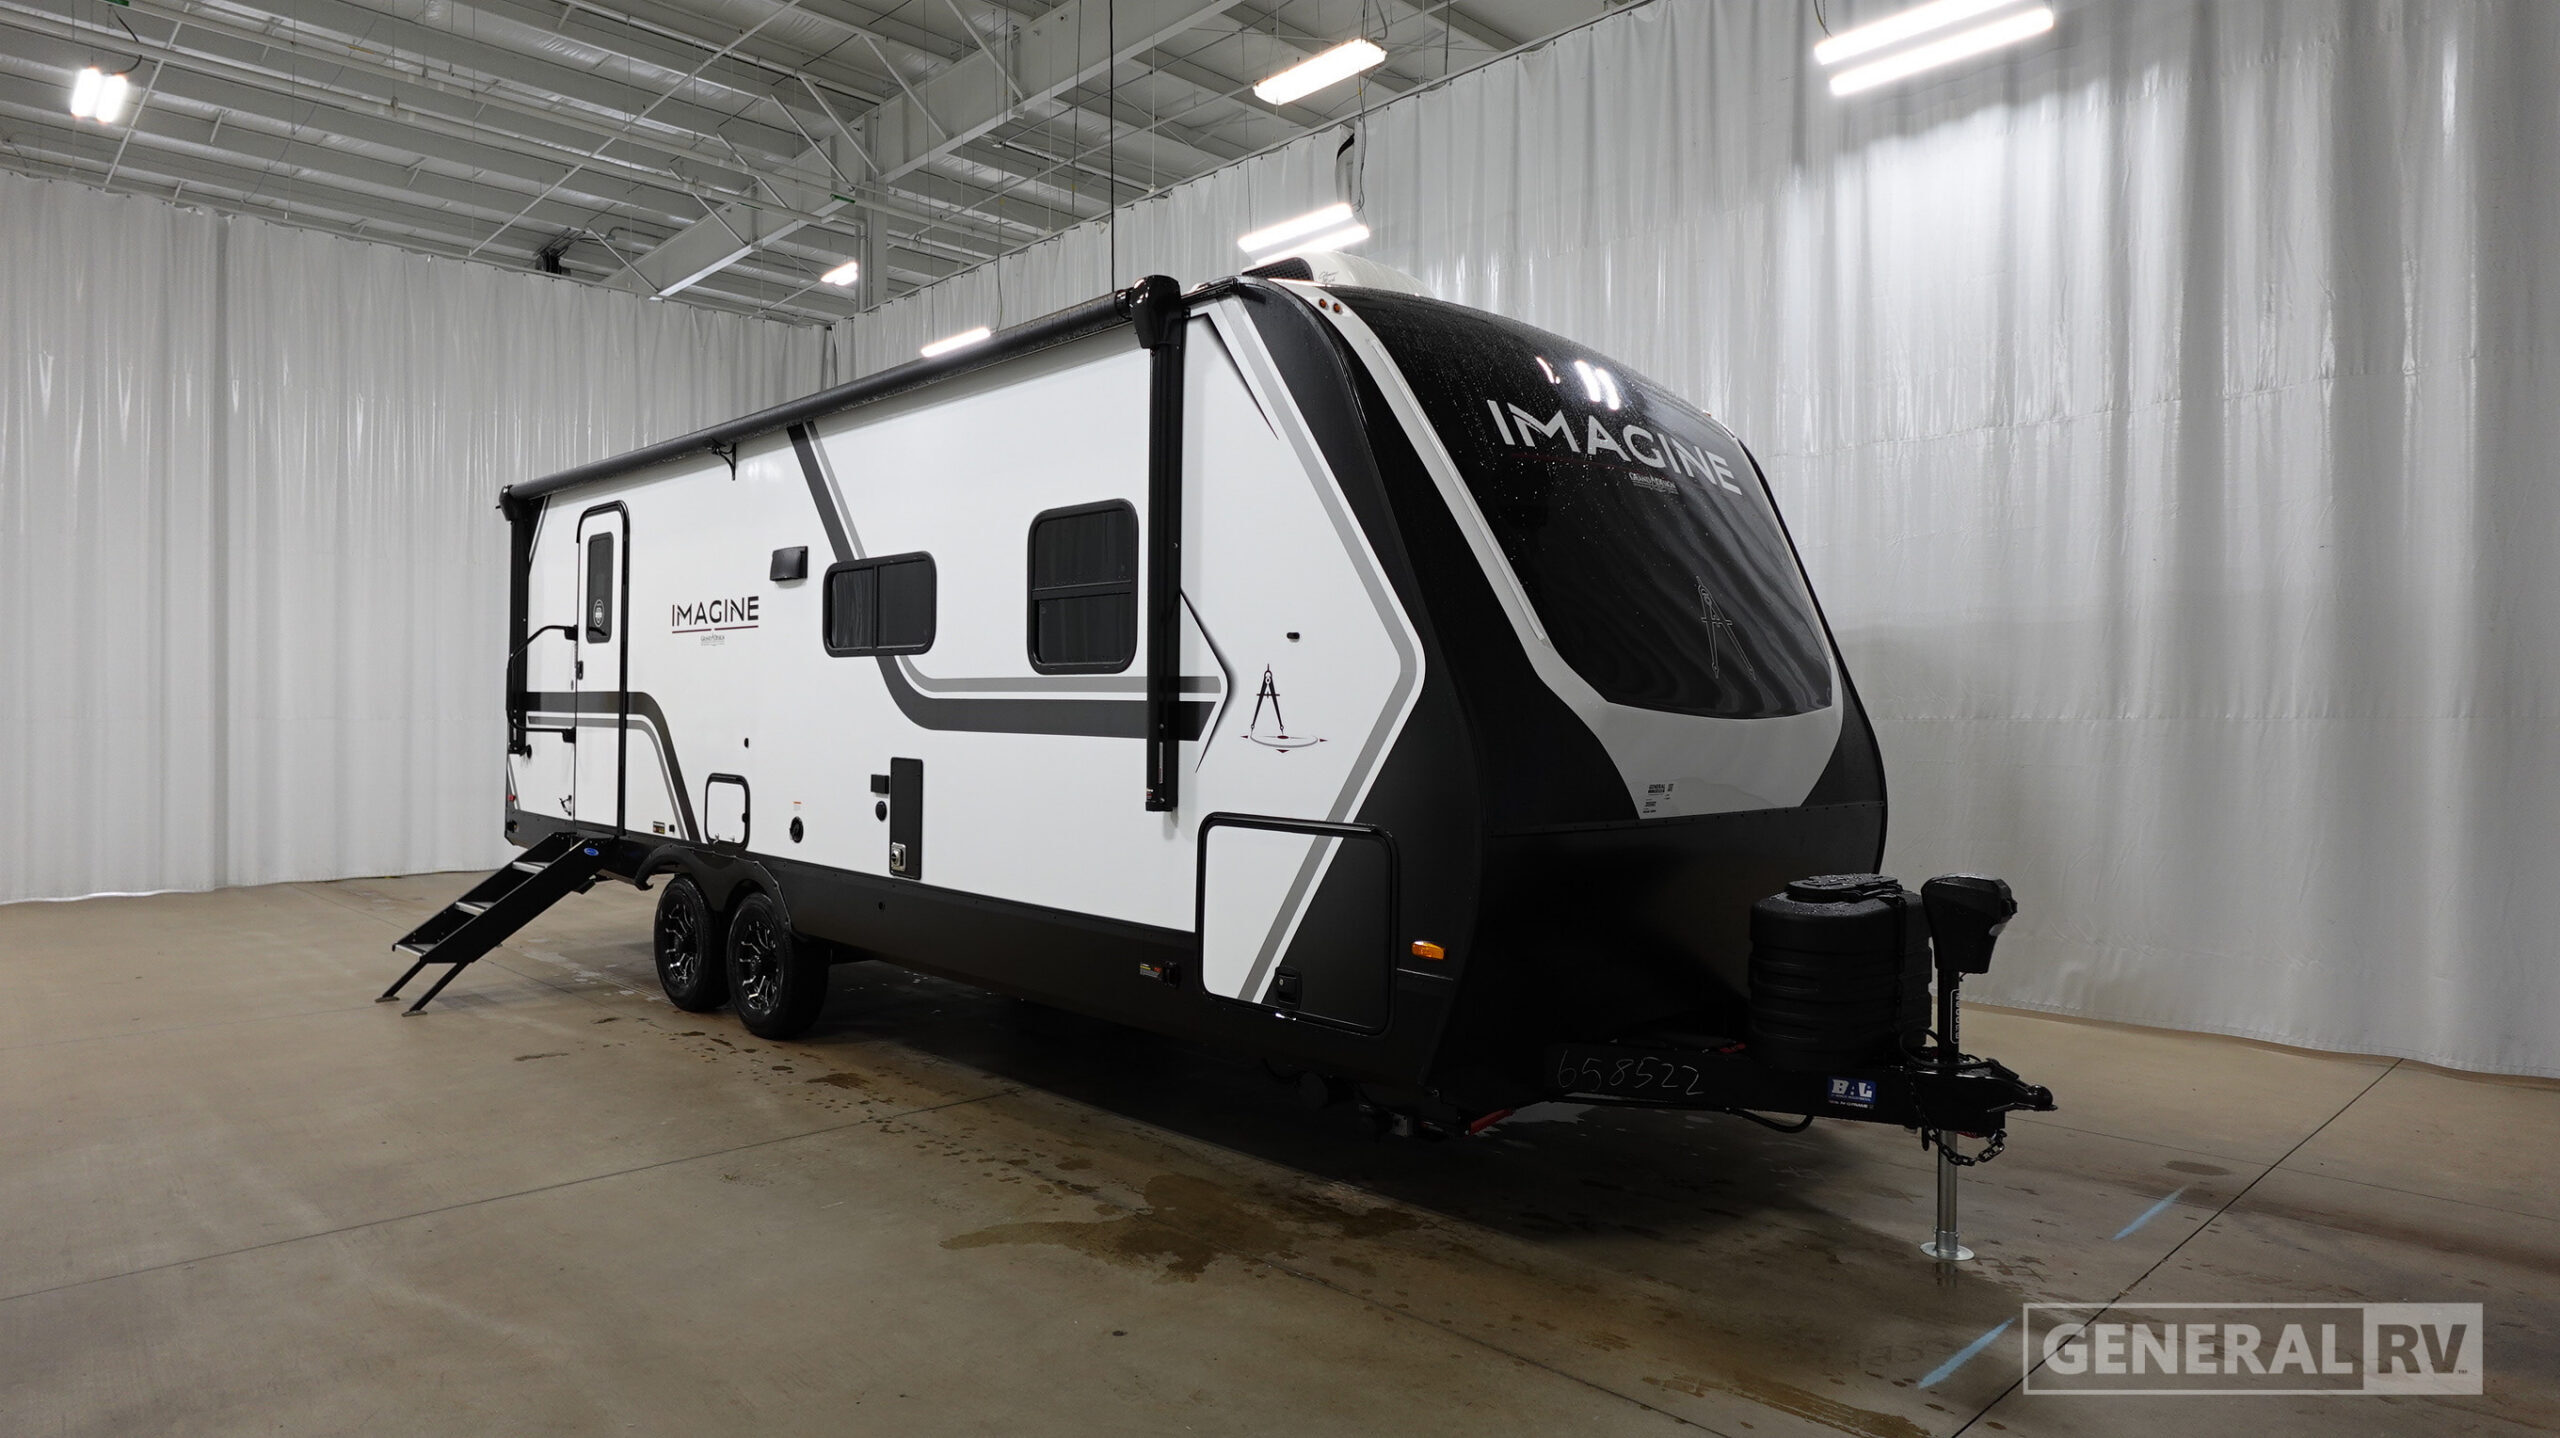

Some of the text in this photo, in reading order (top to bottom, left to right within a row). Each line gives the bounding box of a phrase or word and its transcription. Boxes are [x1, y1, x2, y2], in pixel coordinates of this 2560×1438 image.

[1486, 399, 1742, 496] IMAGINE
[672, 596, 759, 627] IMAGINE
[1556, 1048, 1705, 1096] 658522
